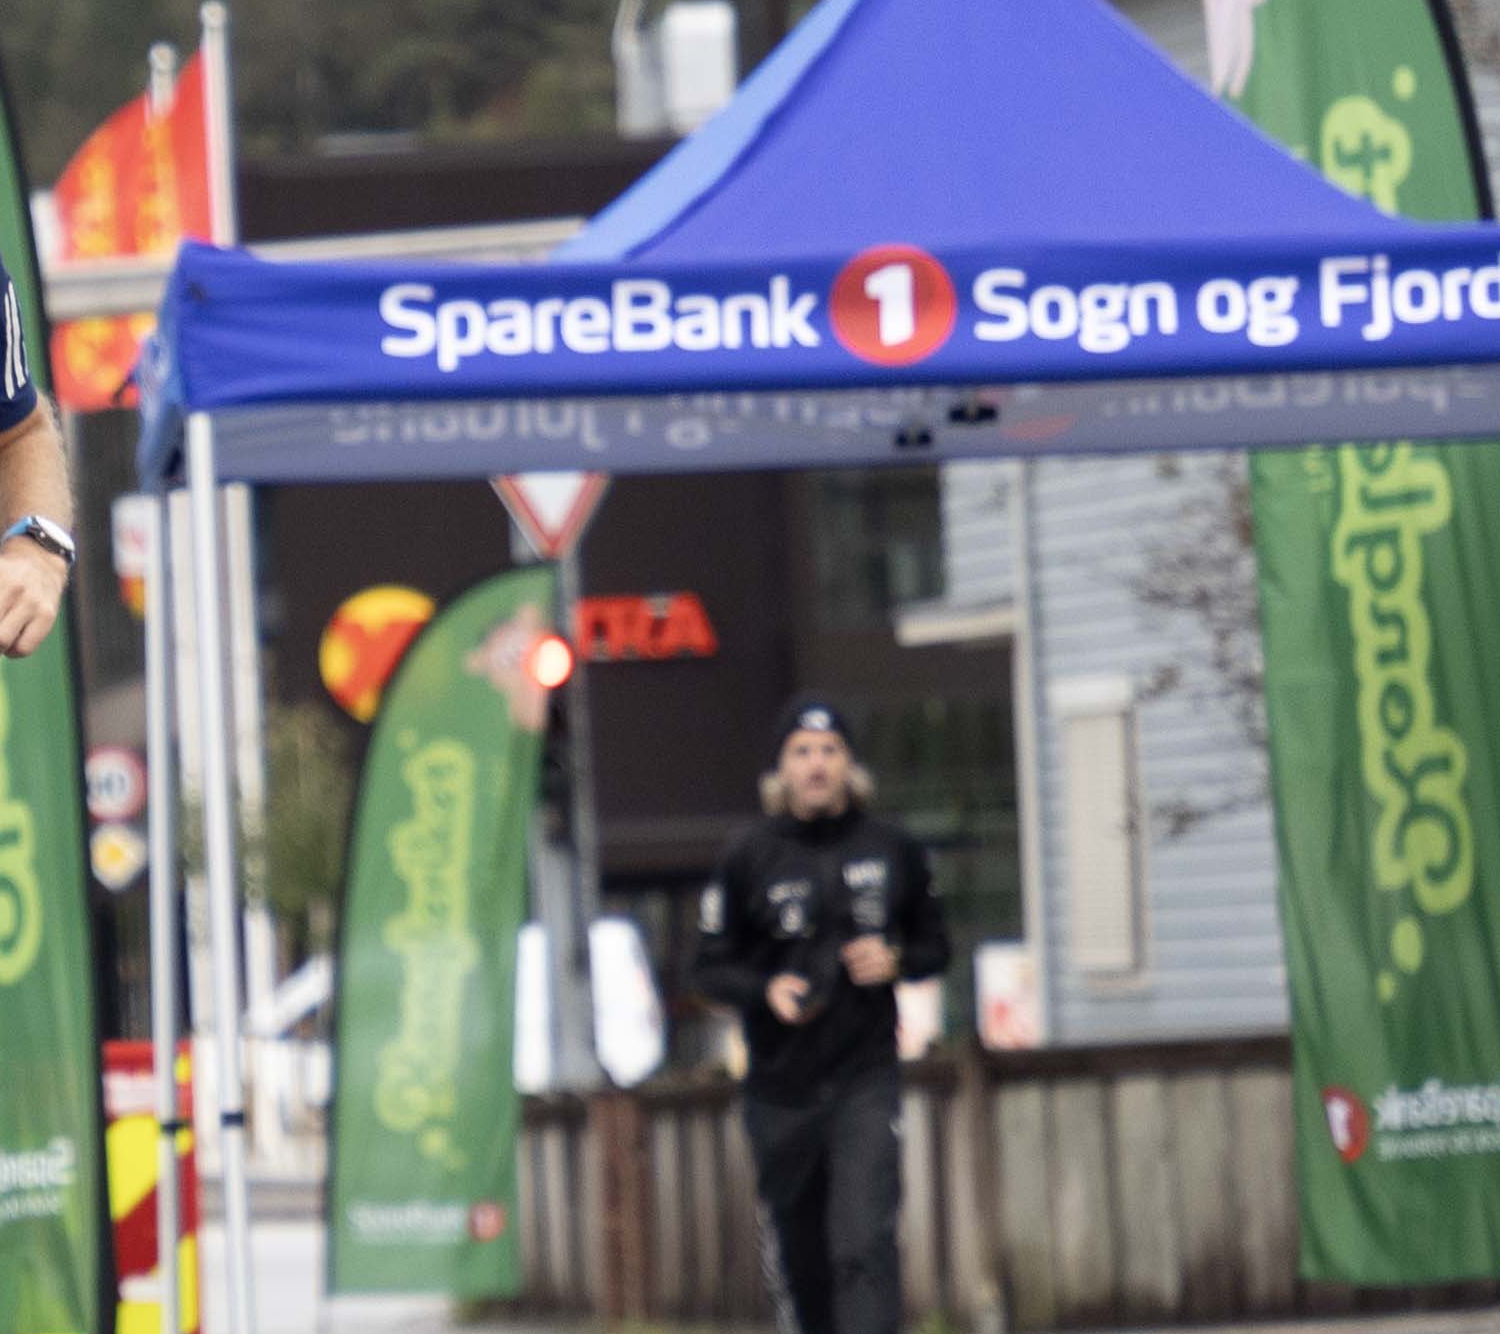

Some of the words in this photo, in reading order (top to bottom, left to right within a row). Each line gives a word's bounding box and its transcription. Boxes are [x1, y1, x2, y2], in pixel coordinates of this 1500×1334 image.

[379, 276, 820, 371] SpareBank
[972, 269, 1179, 353] Sogn
[1197, 276, 1300, 346] og
